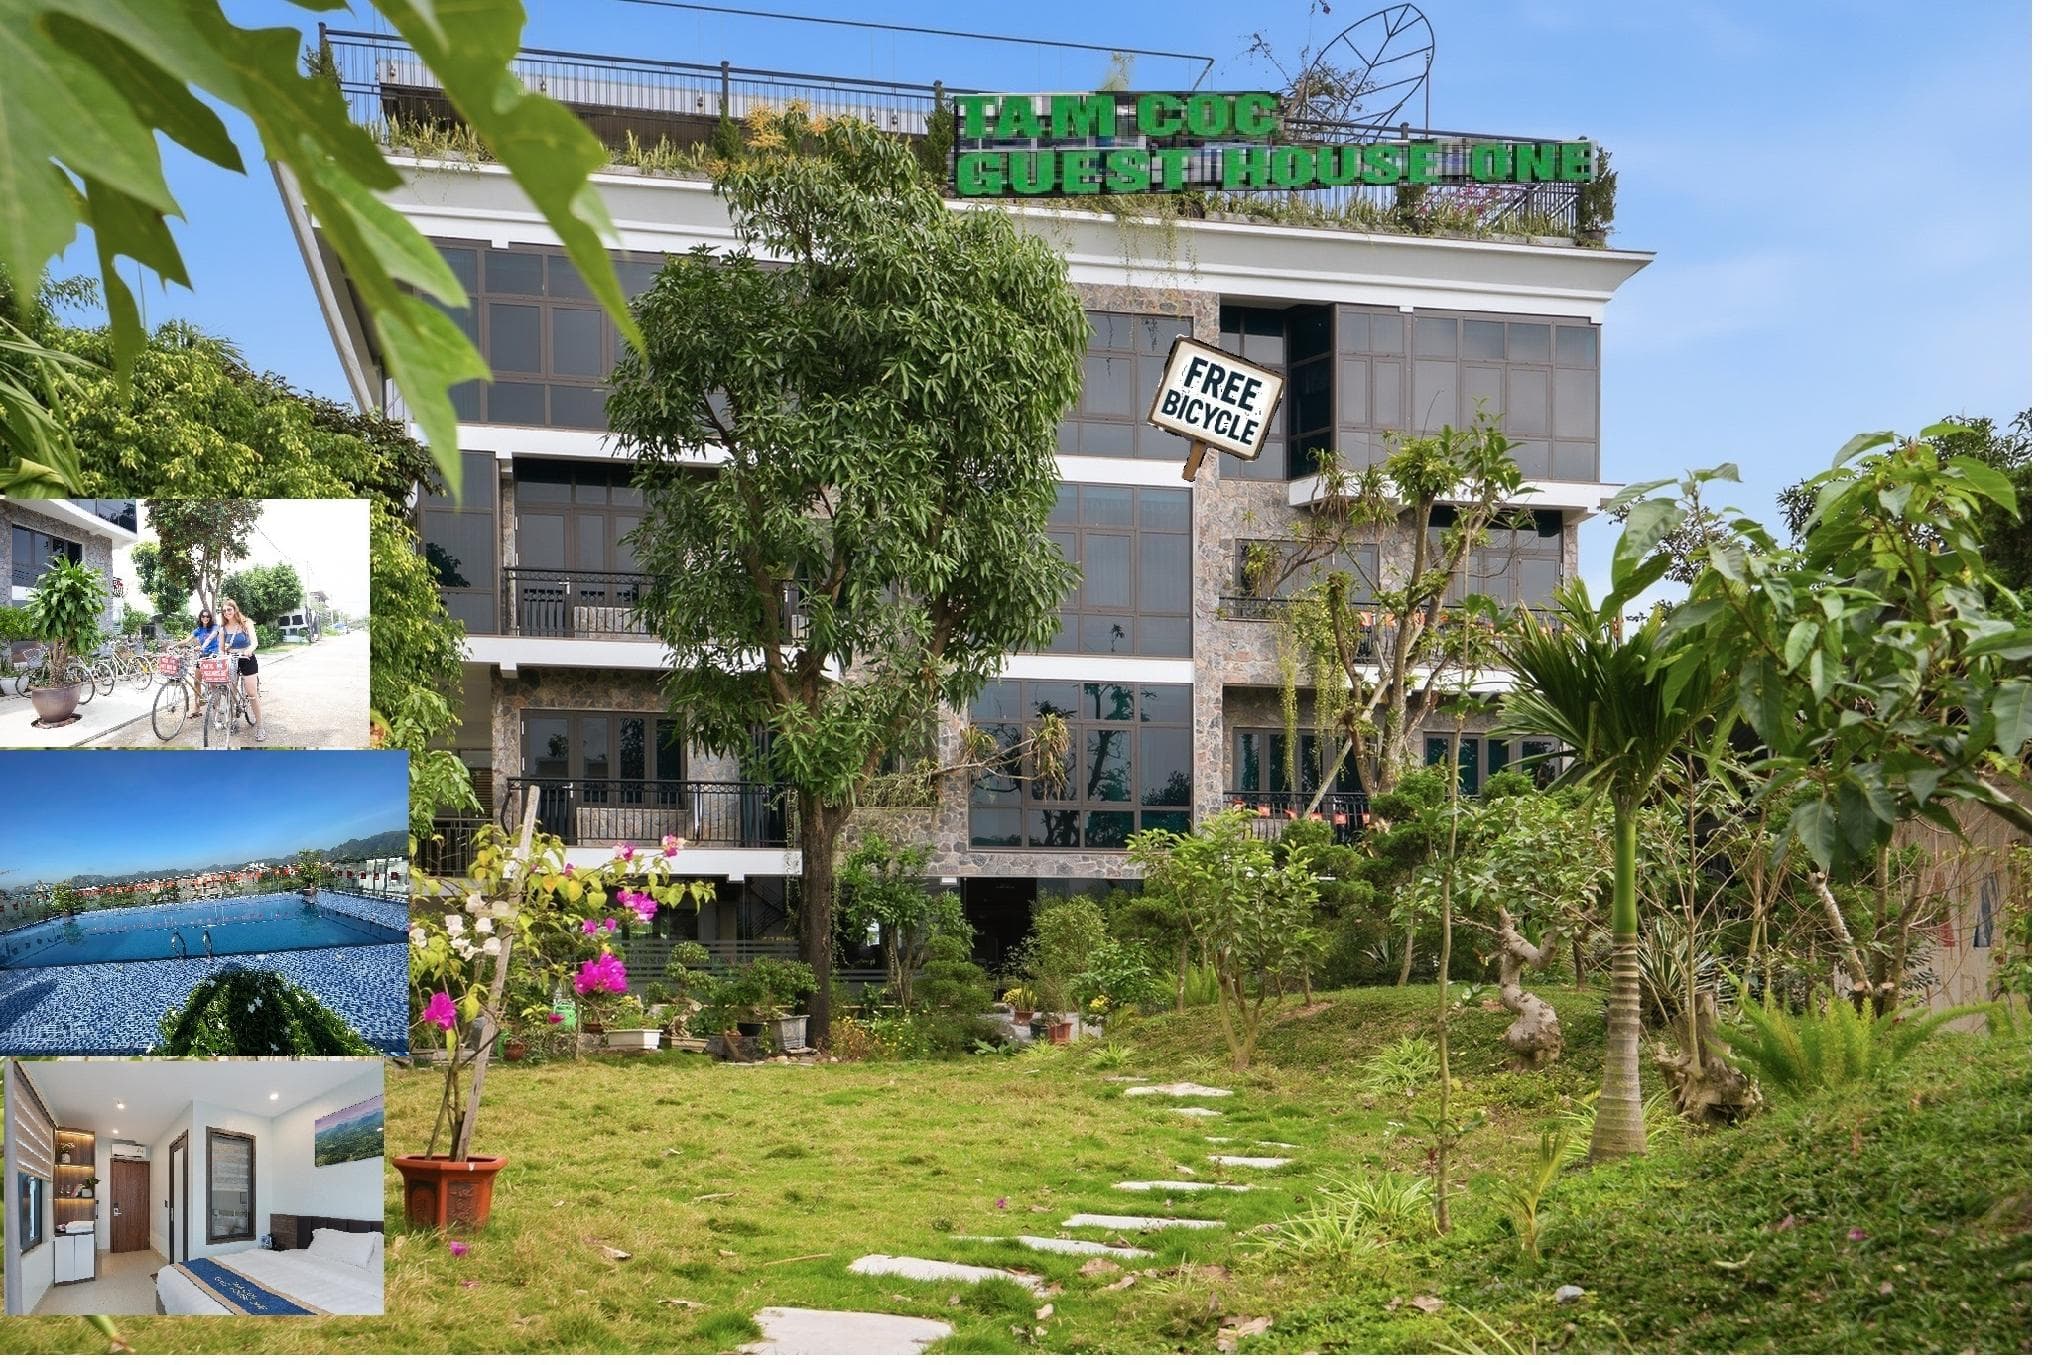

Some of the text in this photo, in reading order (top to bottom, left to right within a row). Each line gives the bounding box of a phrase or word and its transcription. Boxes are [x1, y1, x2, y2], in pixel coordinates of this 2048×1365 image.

[962, 93, 1280, 138] TAM COC
[956, 141, 1594, 196] GUEST HOUSE ONE
